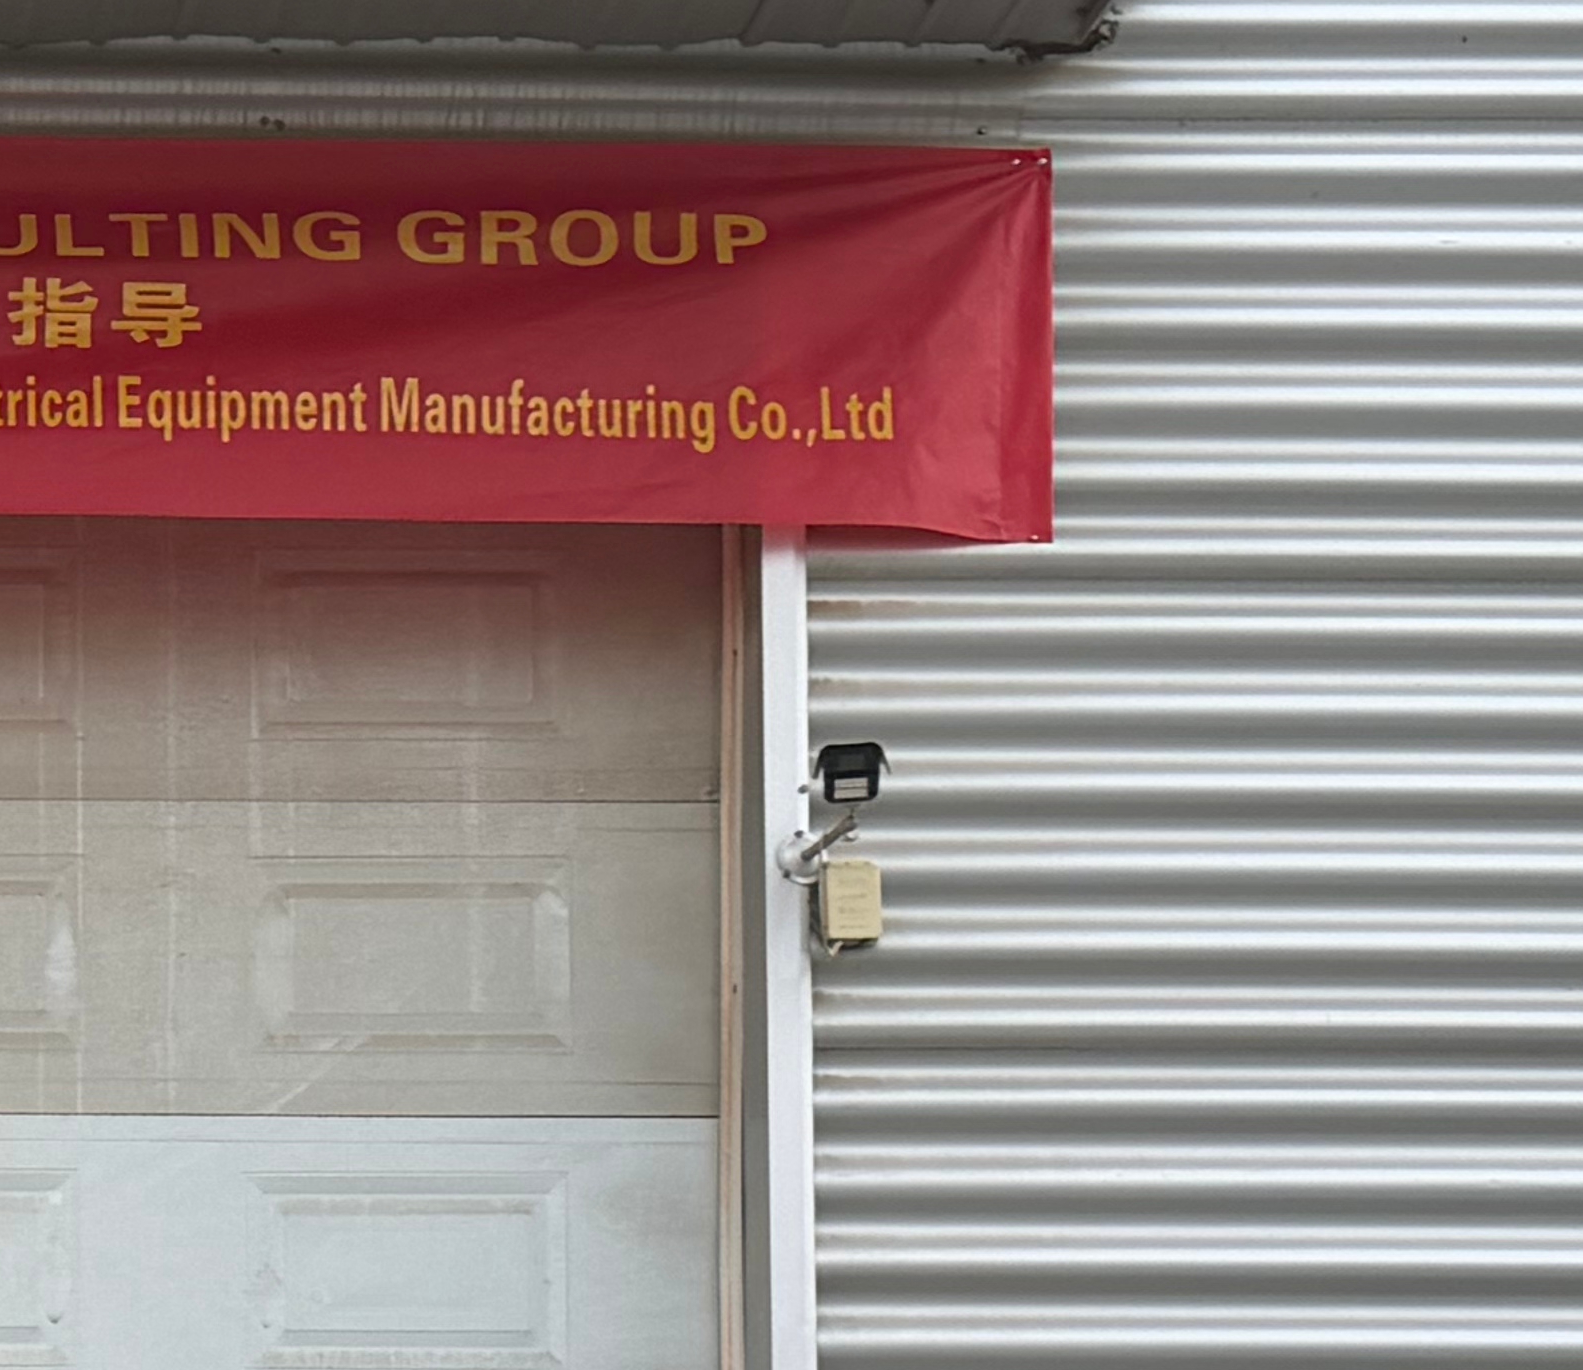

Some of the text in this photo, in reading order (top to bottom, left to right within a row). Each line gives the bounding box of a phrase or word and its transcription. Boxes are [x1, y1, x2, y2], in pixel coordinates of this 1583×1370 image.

[398, 210, 767, 267] GROUP
[117, 375, 368, 443] Equipment
[380, 377, 717, 455] Manufacturing
[727, 386, 895, 446] Co.,Ltd
